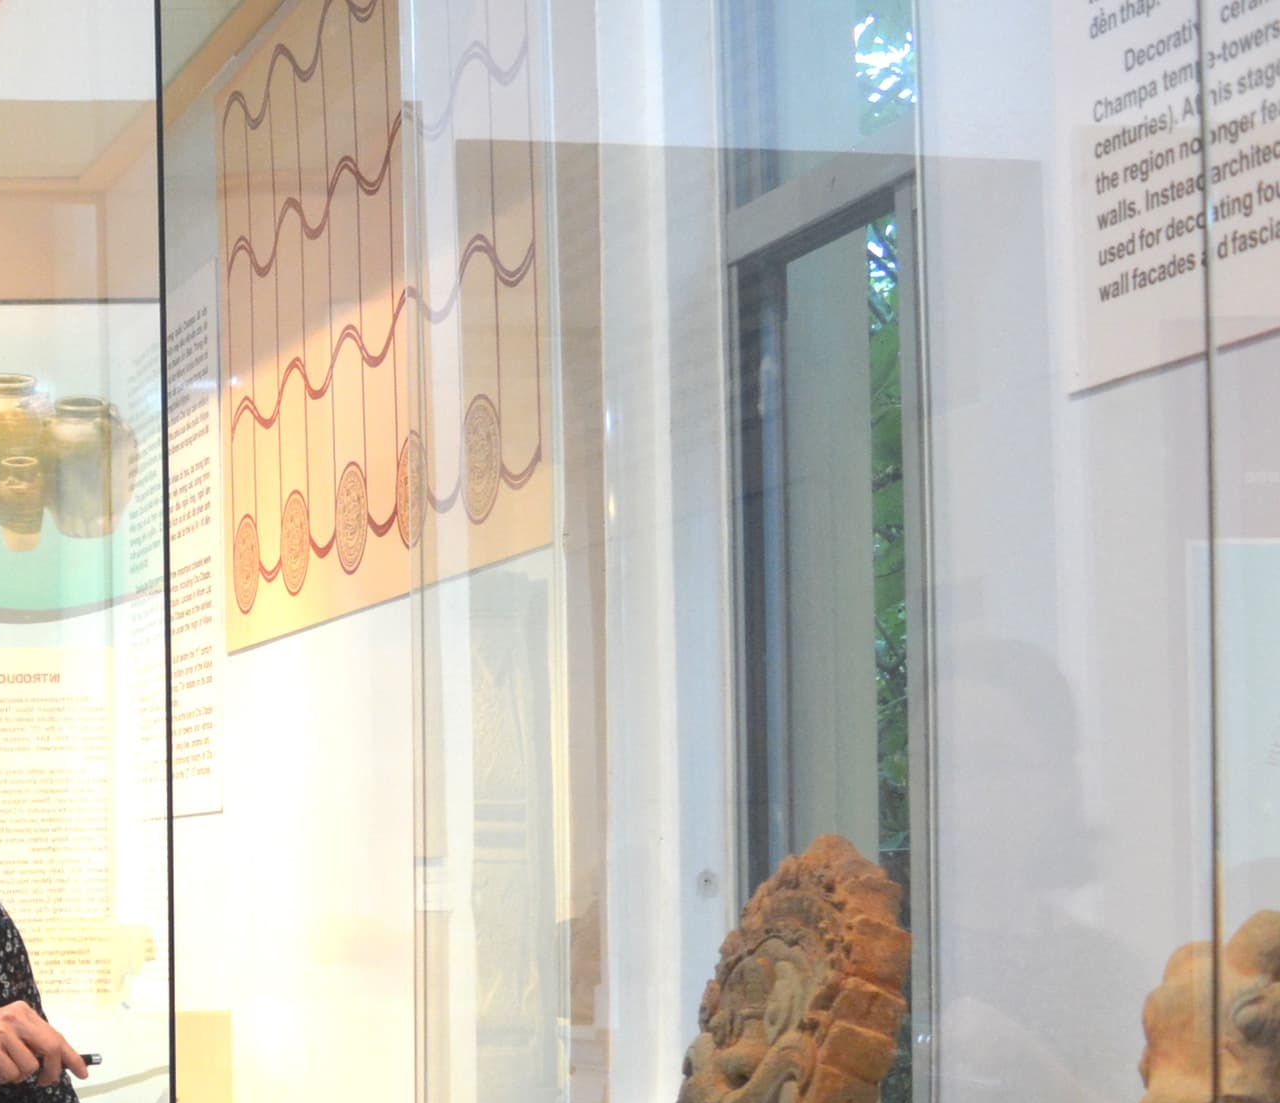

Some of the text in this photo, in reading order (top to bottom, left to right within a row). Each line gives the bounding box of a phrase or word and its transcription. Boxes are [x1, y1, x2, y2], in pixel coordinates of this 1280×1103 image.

[1093, 78, 1158, 125] Champa
[1094, 103, 1179, 159] centuries).
[1096, 169, 1120, 196] the
[1123, 146, 1176, 184] region
[1179, 136, 1204, 161] no
[1097, 198, 1142, 231] walls.
[1098, 232, 1136, 267] used
[1138, 226, 1163, 252] for
[1166, 191, 1254, 242] decoating
[1099, 272, 1130, 303] wall
[1132, 251, 1197, 291] facades
